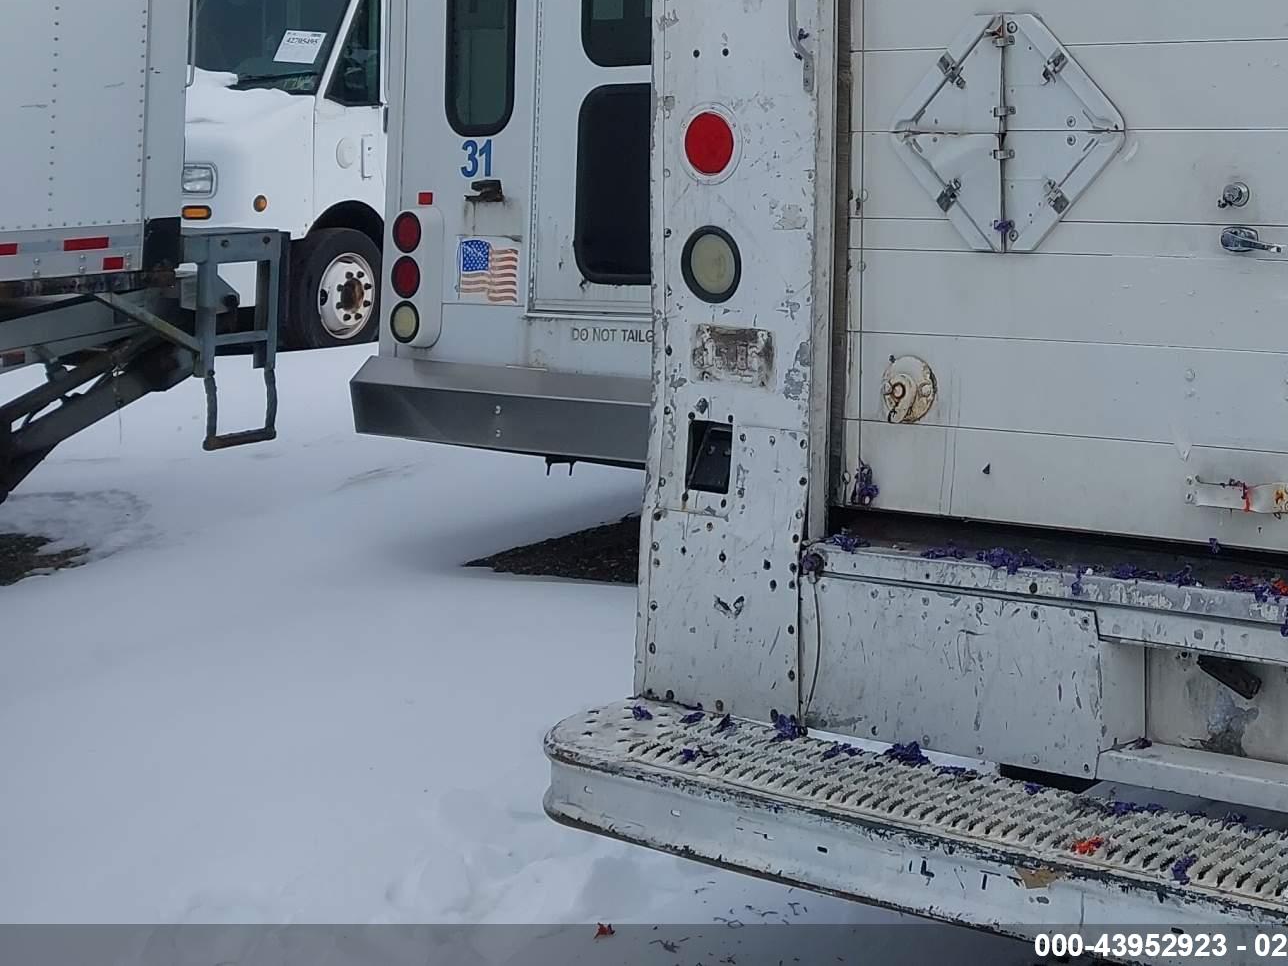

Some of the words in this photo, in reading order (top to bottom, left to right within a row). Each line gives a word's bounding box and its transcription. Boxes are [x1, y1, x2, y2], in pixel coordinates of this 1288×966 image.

[460, 139, 493, 178] 31
[571, 327, 589, 342] DO
[592, 327, 617, 342] NOT
